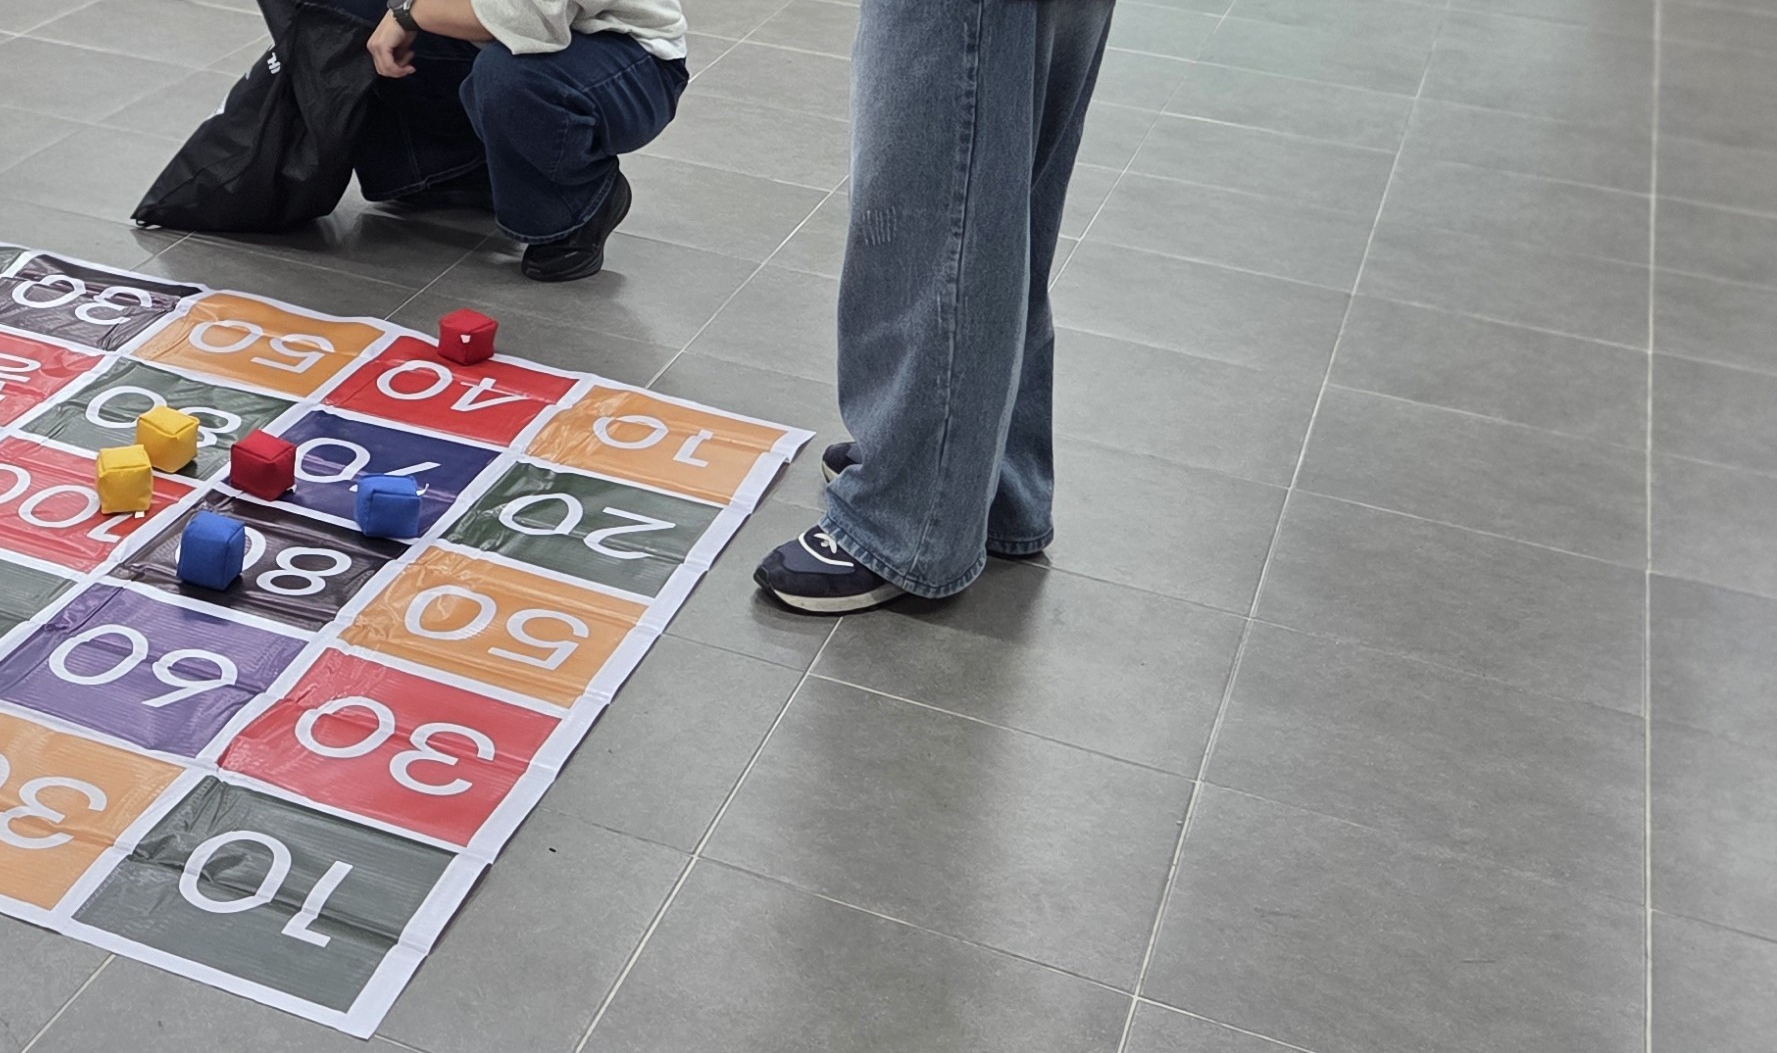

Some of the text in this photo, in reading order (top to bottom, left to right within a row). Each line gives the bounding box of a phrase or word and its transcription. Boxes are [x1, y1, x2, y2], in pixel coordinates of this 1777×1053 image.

[11, 274, 152, 325] 30
[189, 319, 336, 374] 50
[377, 359, 527, 413] 40
[592, 414, 713, 467] 10
[499, 493, 676, 560] 20
[404, 585, 590, 671] 50
[49, 624, 238, 708] 60
[295, 695, 495, 796] 30
[179, 830, 353, 947] 10
